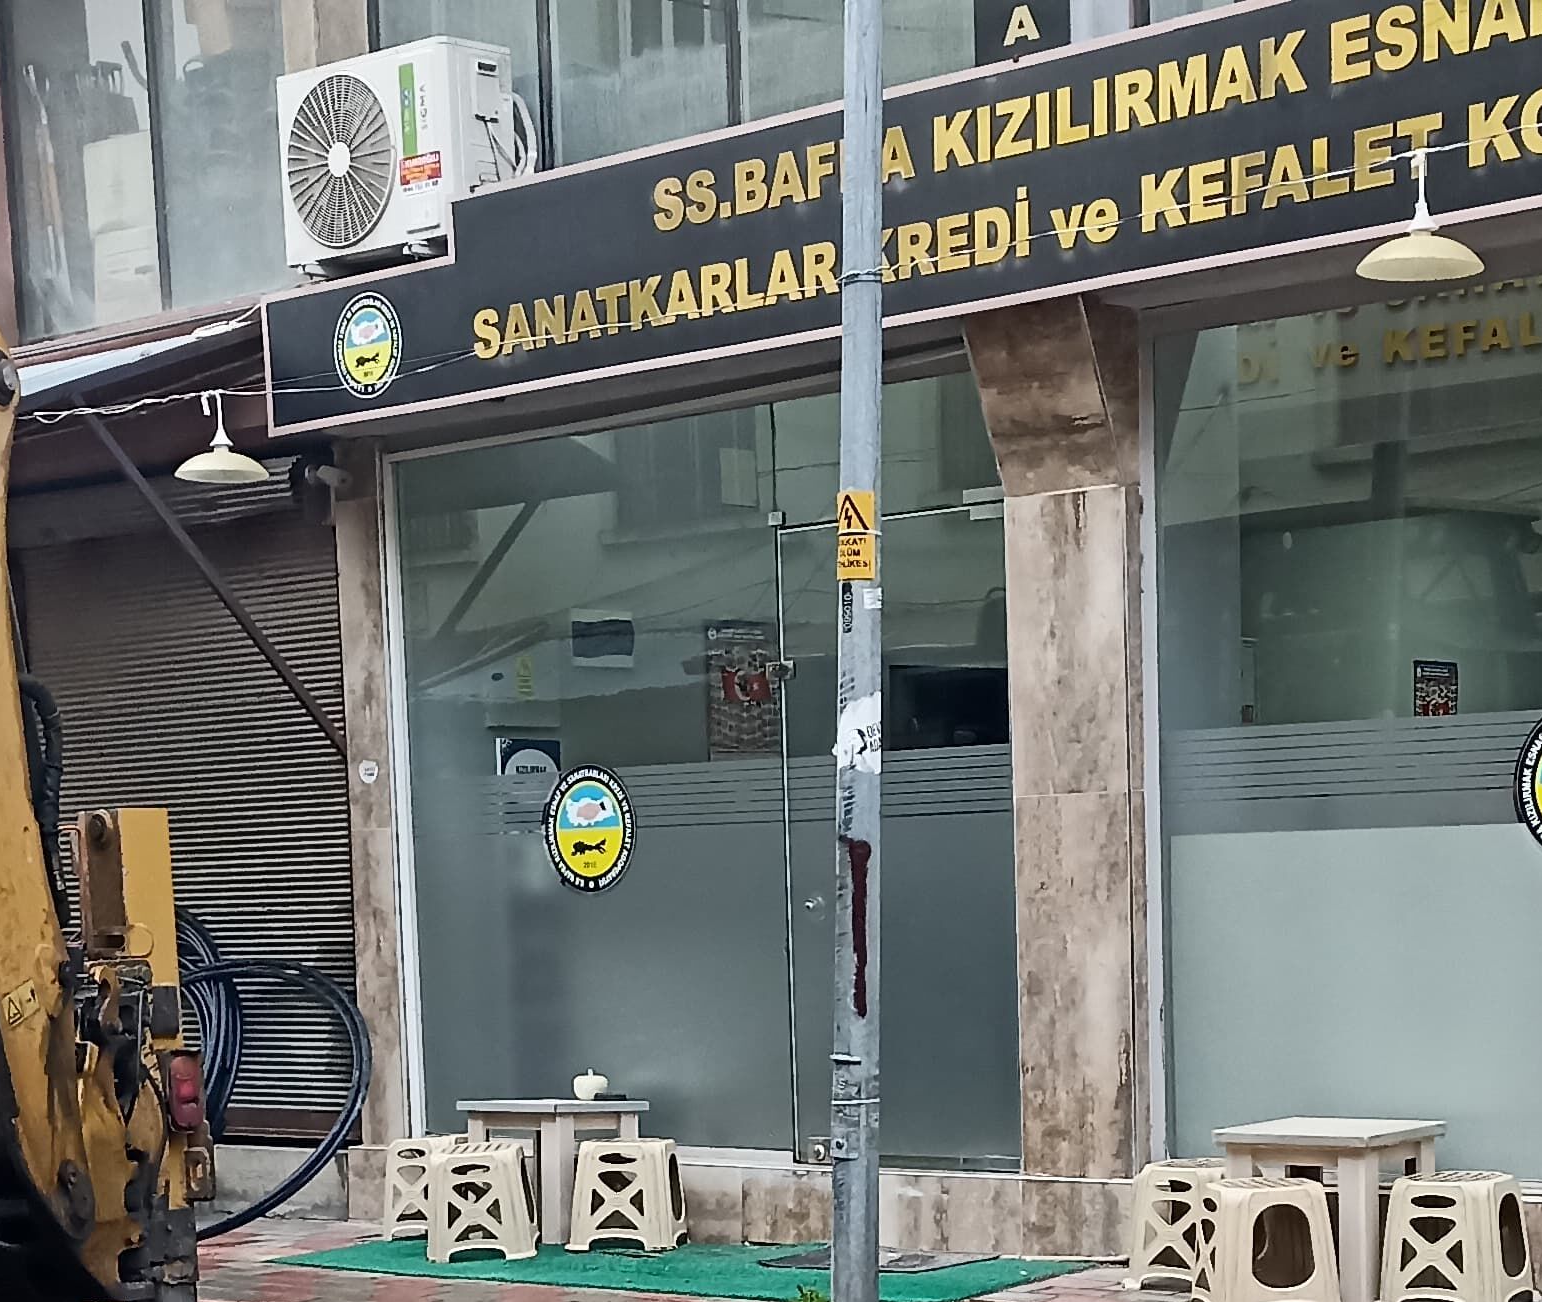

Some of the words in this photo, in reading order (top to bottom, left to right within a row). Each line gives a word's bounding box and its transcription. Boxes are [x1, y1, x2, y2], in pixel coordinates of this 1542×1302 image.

[1003, 4, 1040, 46] A
[653, 127, 914, 231] SS.BAFA
[932, 28, 1309, 172] KIZILIRMAK
[1051, 197, 1119, 249] ve
[1140, 111, 1442, 232] KEFALET
